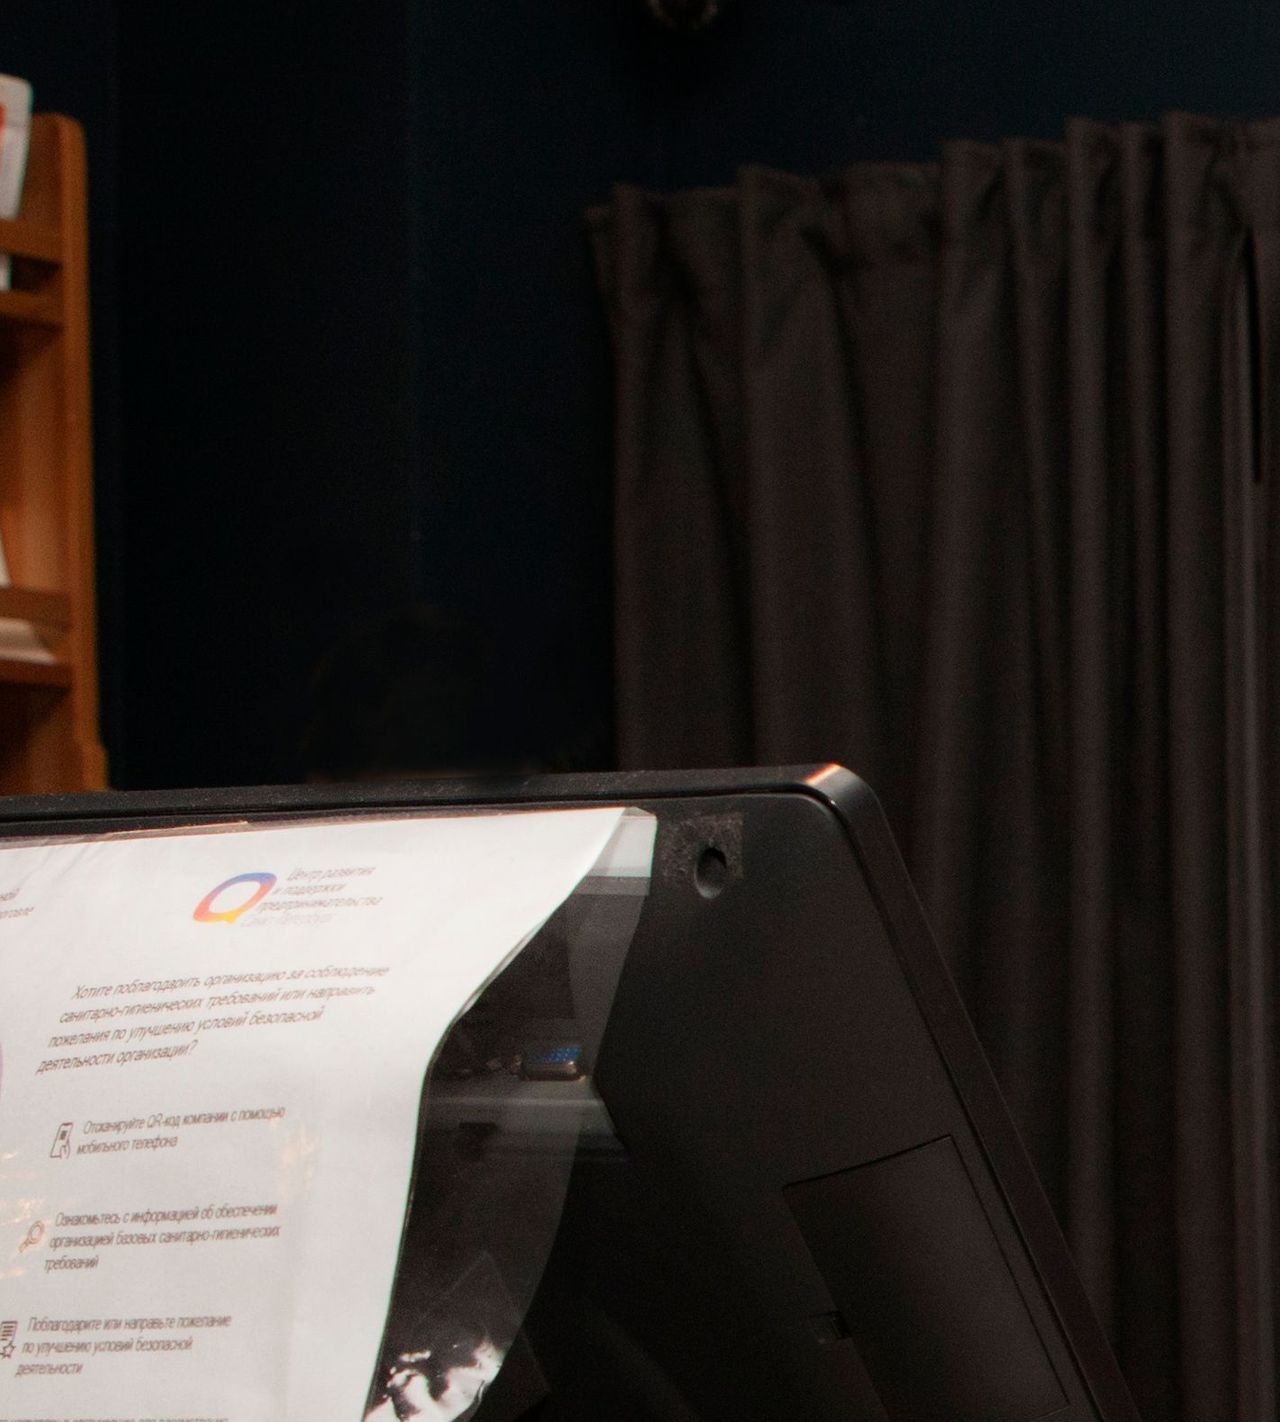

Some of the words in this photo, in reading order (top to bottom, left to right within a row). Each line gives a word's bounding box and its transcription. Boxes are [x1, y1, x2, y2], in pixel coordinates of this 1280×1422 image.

[72, 984, 113, 1000] Хотите
[48, 1028, 112, 1048] пожелания
[35, 1052, 116, 1076] деятельности
